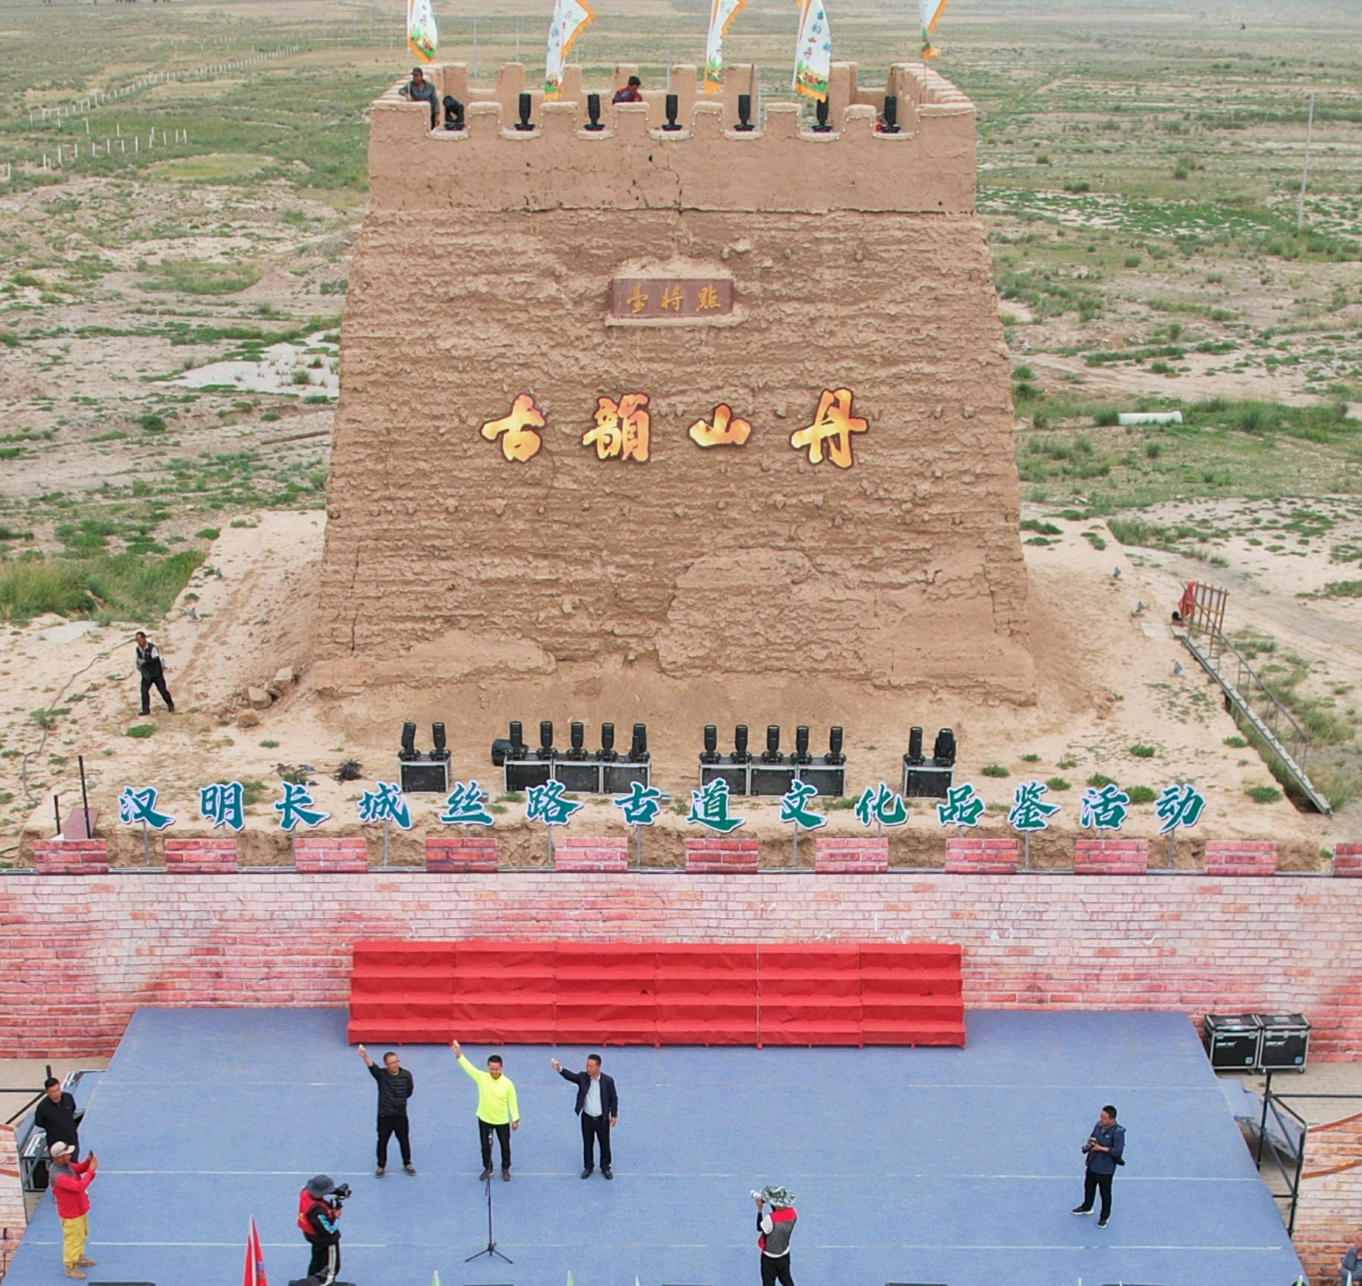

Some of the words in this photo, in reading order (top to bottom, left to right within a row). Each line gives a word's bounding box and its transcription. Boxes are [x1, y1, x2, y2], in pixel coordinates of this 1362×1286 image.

[118, 778, 1207, 834] 汉明长城丝路古道文化品鉴活动
